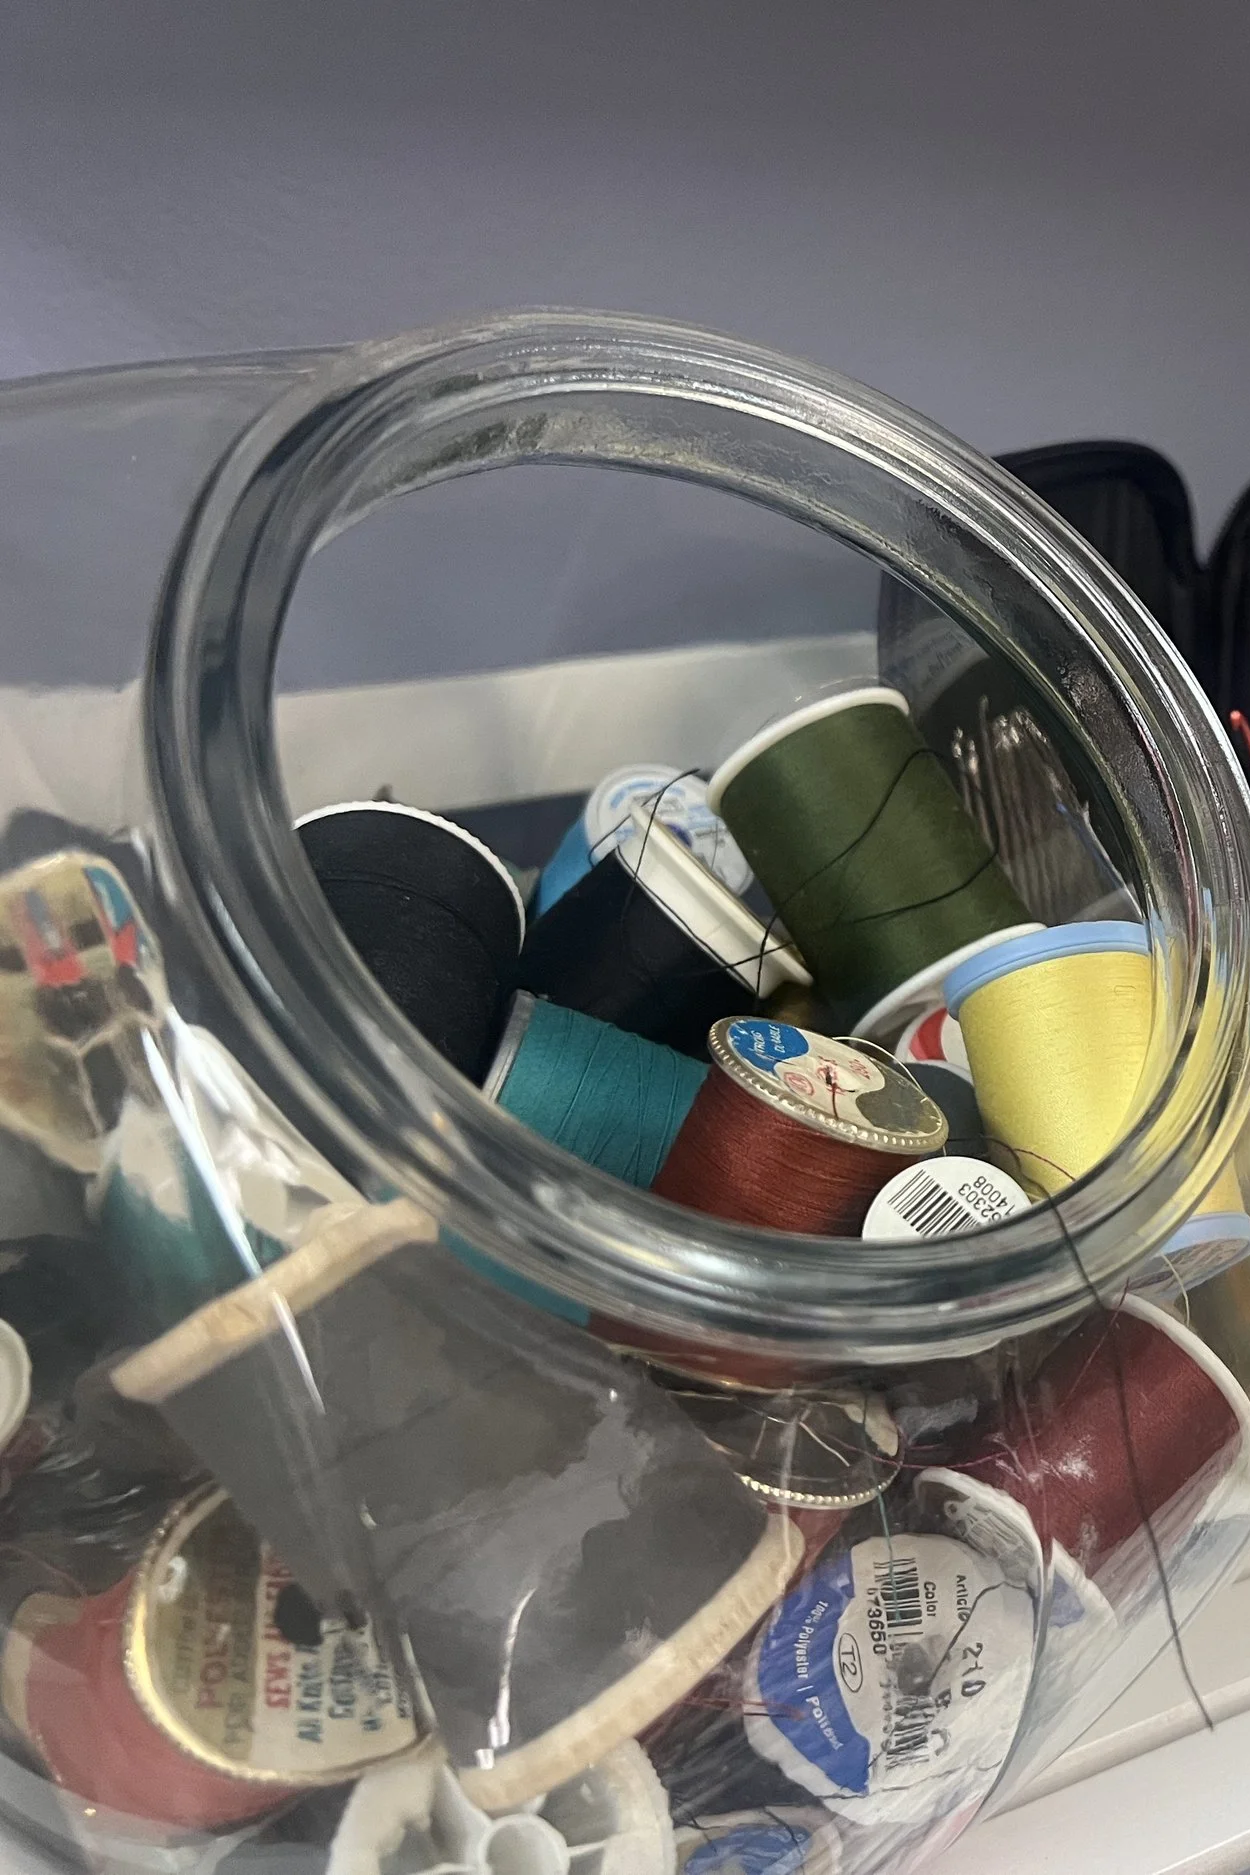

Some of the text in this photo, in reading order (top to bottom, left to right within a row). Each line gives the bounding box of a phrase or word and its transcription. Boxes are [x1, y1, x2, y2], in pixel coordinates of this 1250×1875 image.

[923, 1580, 938, 1618] Color
[794, 1625, 815, 1680] Polyester
[841, 1646, 858, 1677] T2
